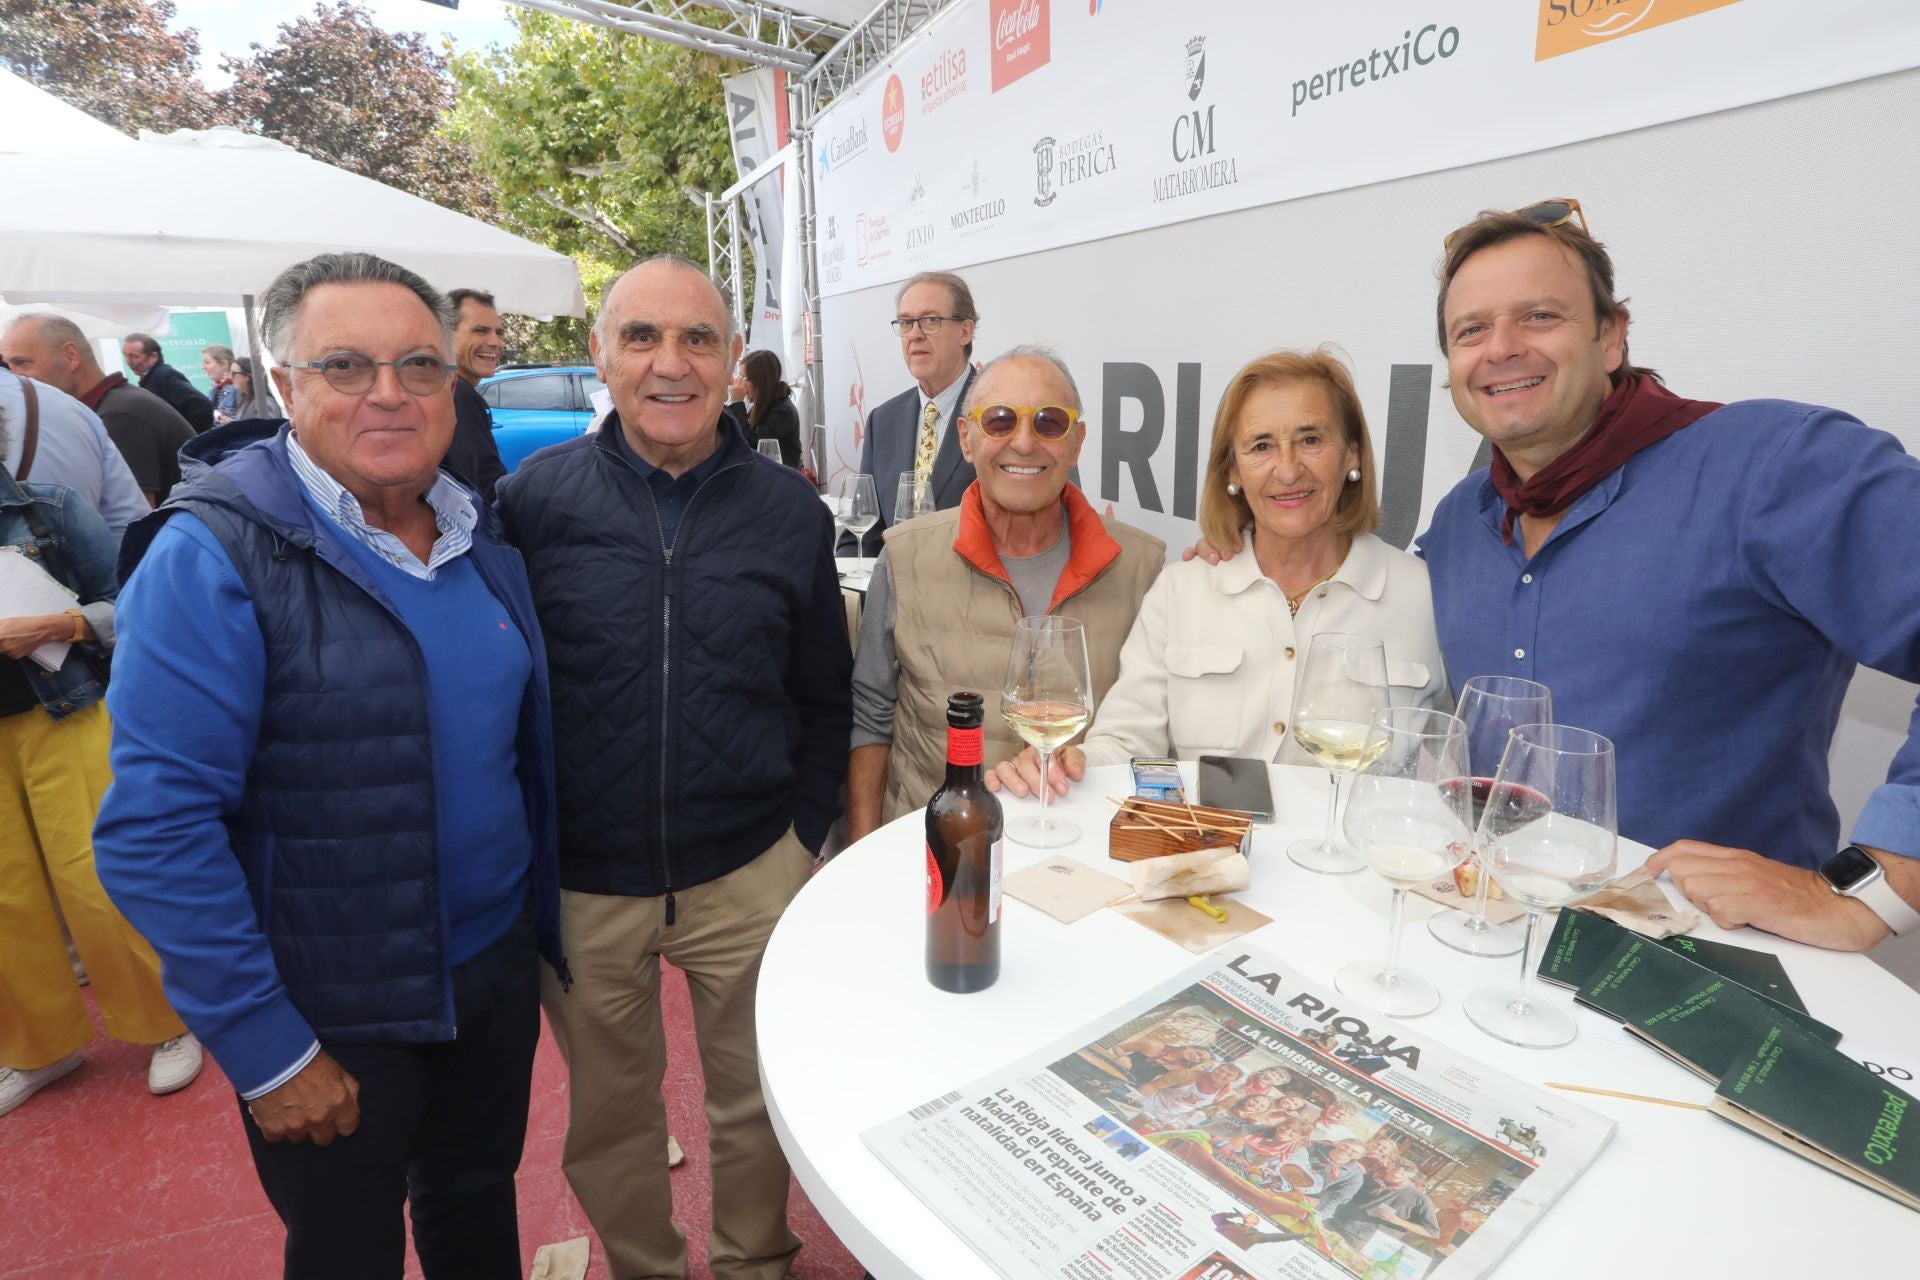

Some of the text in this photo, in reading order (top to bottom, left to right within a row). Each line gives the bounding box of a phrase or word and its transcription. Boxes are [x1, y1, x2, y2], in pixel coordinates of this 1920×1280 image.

[1291, 23, 1460, 116] perretxiCo
[830, 118, 868, 164] CaixaBank
[1059, 130, 1103, 158] BODEGAS
[1172, 104, 1216, 163] CM
[1059, 143, 1117, 187] PERICA
[1153, 156, 1238, 203] MATARROMERA
[951, 198, 1005, 231] MONTECILLO
[906, 223, 935, 250] ZINIO
[1216, 985, 1272, 1014] JUGADORES
[1278, 1020, 1299, 1031] ORO
[1226, 953, 1283, 997] LA
[1286, 991, 1423, 1072] RIOJA
[1238, 1025, 1260, 1040] LA
[1259, 1037, 1326, 1075] LUMBRE
[1324, 1072, 1351, 1089] DE
[1347, 1085, 1372, 1102] LA
[1373, 1099, 1433, 1136] FIESTA
[995, 1088, 1015, 1103] La
[1012, 1101, 1050, 1130] Rioja
[1047, 1128, 1091, 1163] lidera
[1084, 1161, 1134, 1196] junto
[1132, 1195, 1147, 1206] a
[1863, 1088, 1909, 1166] perretxiCo
[960, 1107, 1101, 1221] natalidad en España
[978, 1097, 1126, 1215] Madrid el repunte de
[1127, 1221, 1165, 1249] para robarle
[1146, 1209, 1173, 1229] mientras
[1154, 1222, 1187, 1248] temporero
[1103, 1248, 1119, 1262] hace
[1111, 1244, 1129, 1260] Santo
[1119, 1243, 1163, 1278] Ayuntamiento
[1123, 1236, 1148, 1257] fractura
[1147, 1255, 1171, 1275] interna
[1143, 1223, 1164, 1240] Rincón
[1173, 1245, 1189, 1259] Soto
[1087, 1259, 1105, 1275] novio
